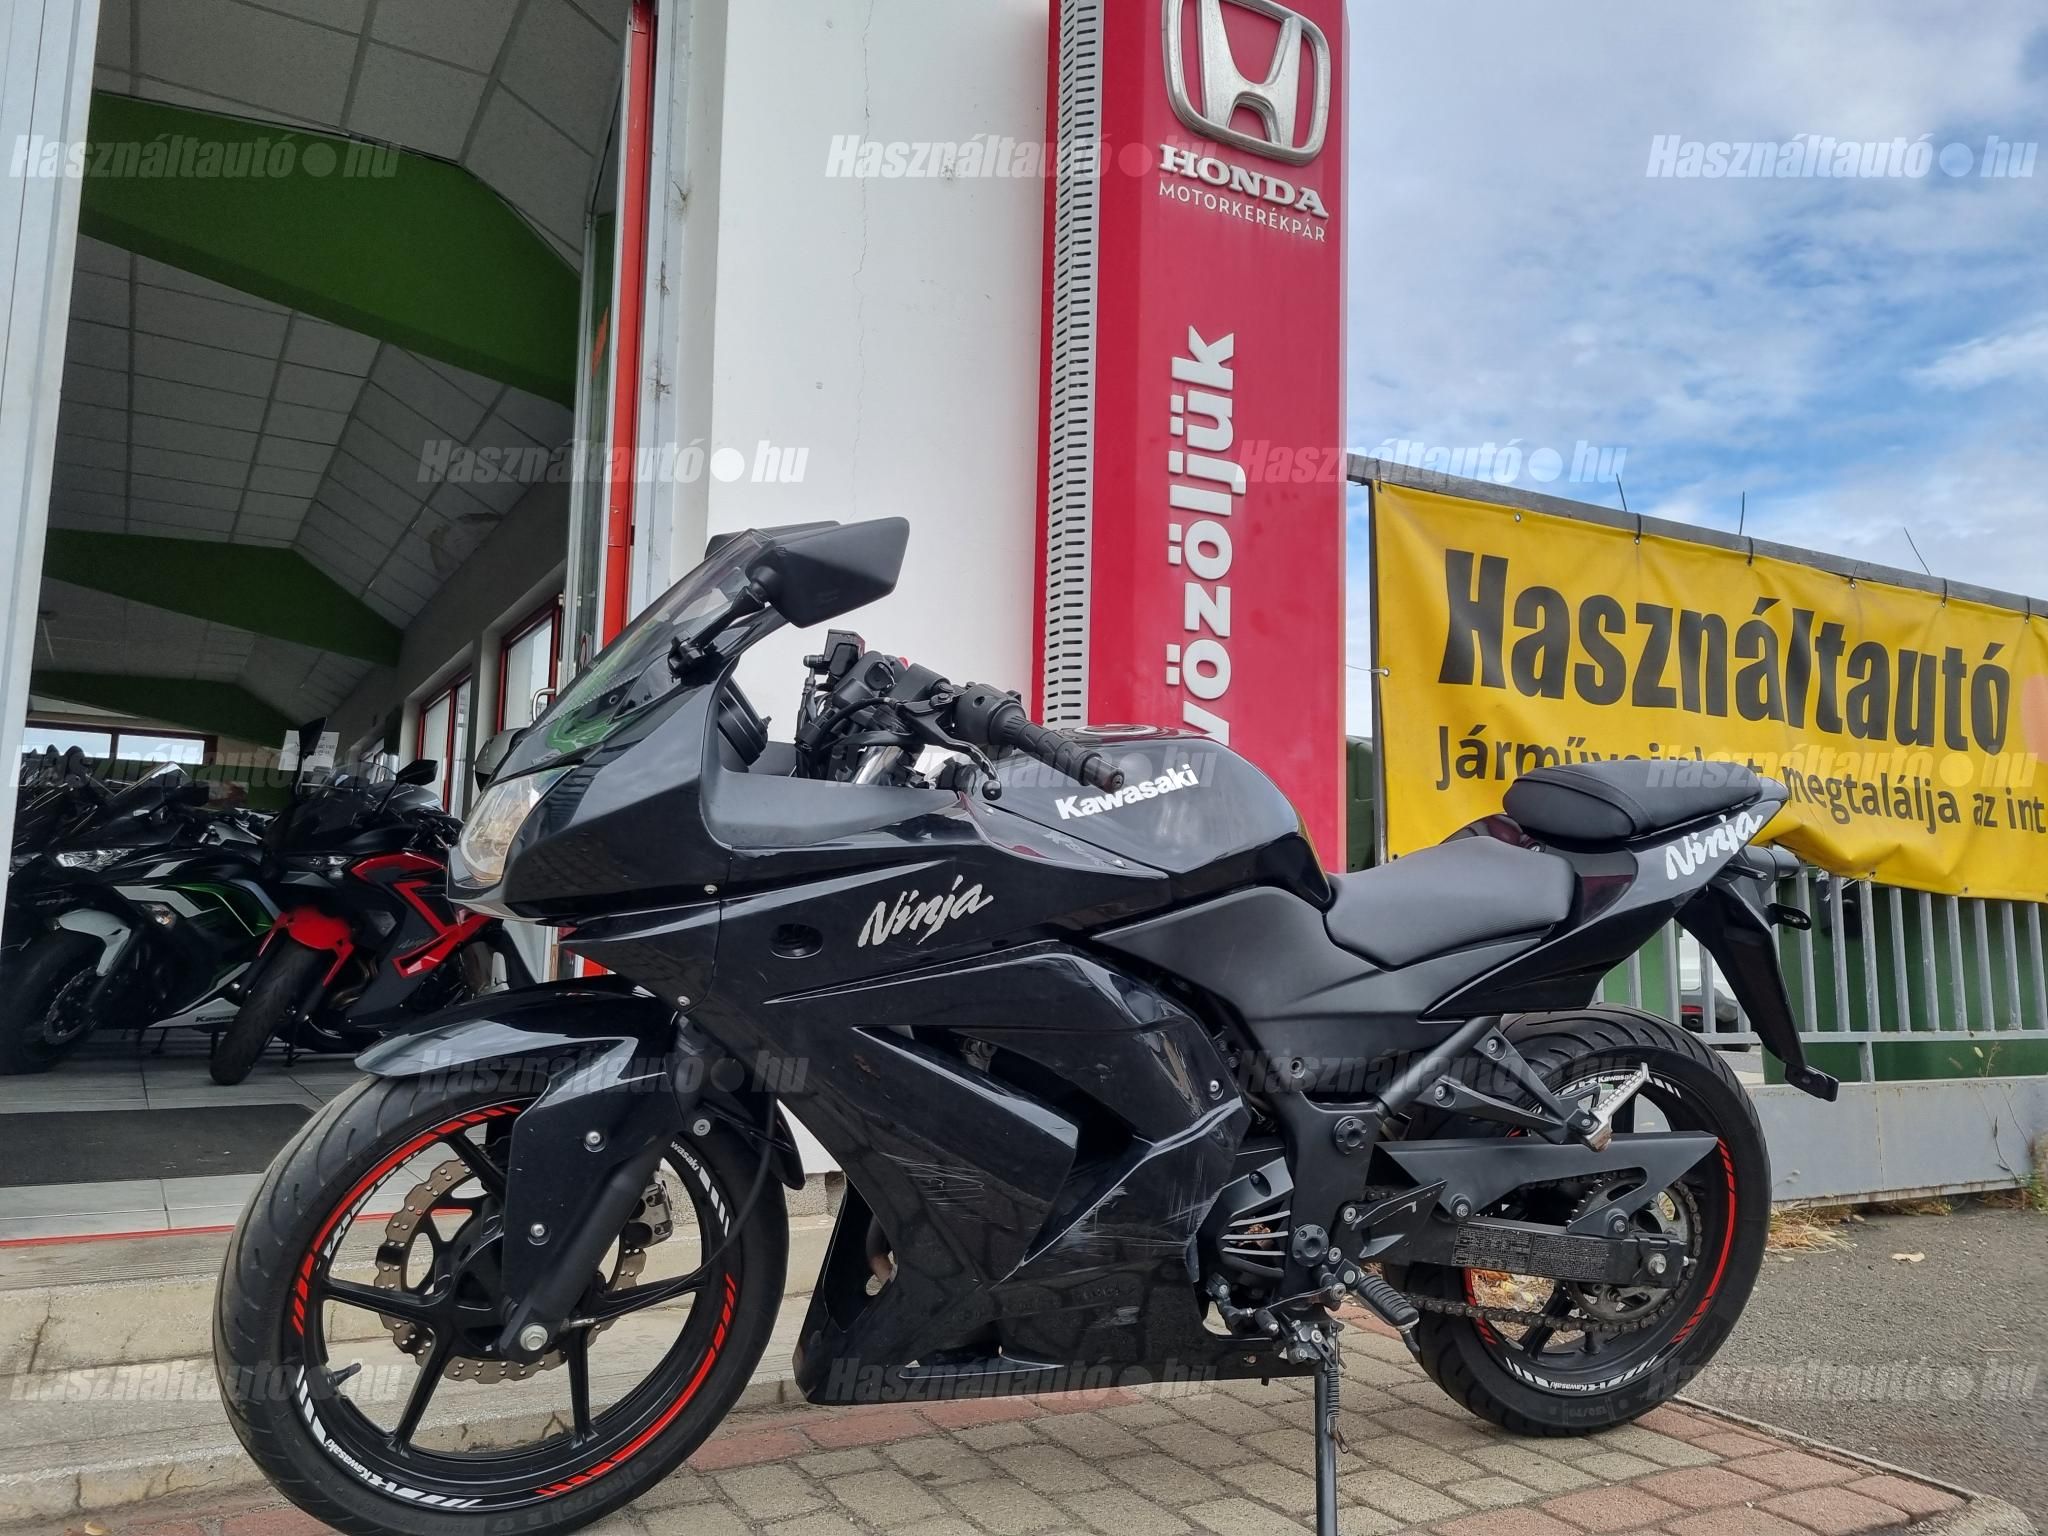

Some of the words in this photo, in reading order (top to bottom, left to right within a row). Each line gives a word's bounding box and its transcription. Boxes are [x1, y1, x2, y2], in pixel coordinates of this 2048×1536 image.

[1159, 143, 1329, 219] HONDA
[1159, 181, 1326, 242] MOTORKERÉKPÁR
[1438, 549, 2011, 756] Használtautó
[1055, 764, 1199, 820] Kawasaki
[1782, 766, 1961, 834] megtalálja
[1973, 793, 1998, 828] az
[2006, 787, 2047, 833] int
[1666, 812, 1763, 880] Ninja
[857, 874, 994, 948] Ninja
[670, 1141, 700, 1171] wasaki
[324, 1438, 372, 1481] Kawasaki
